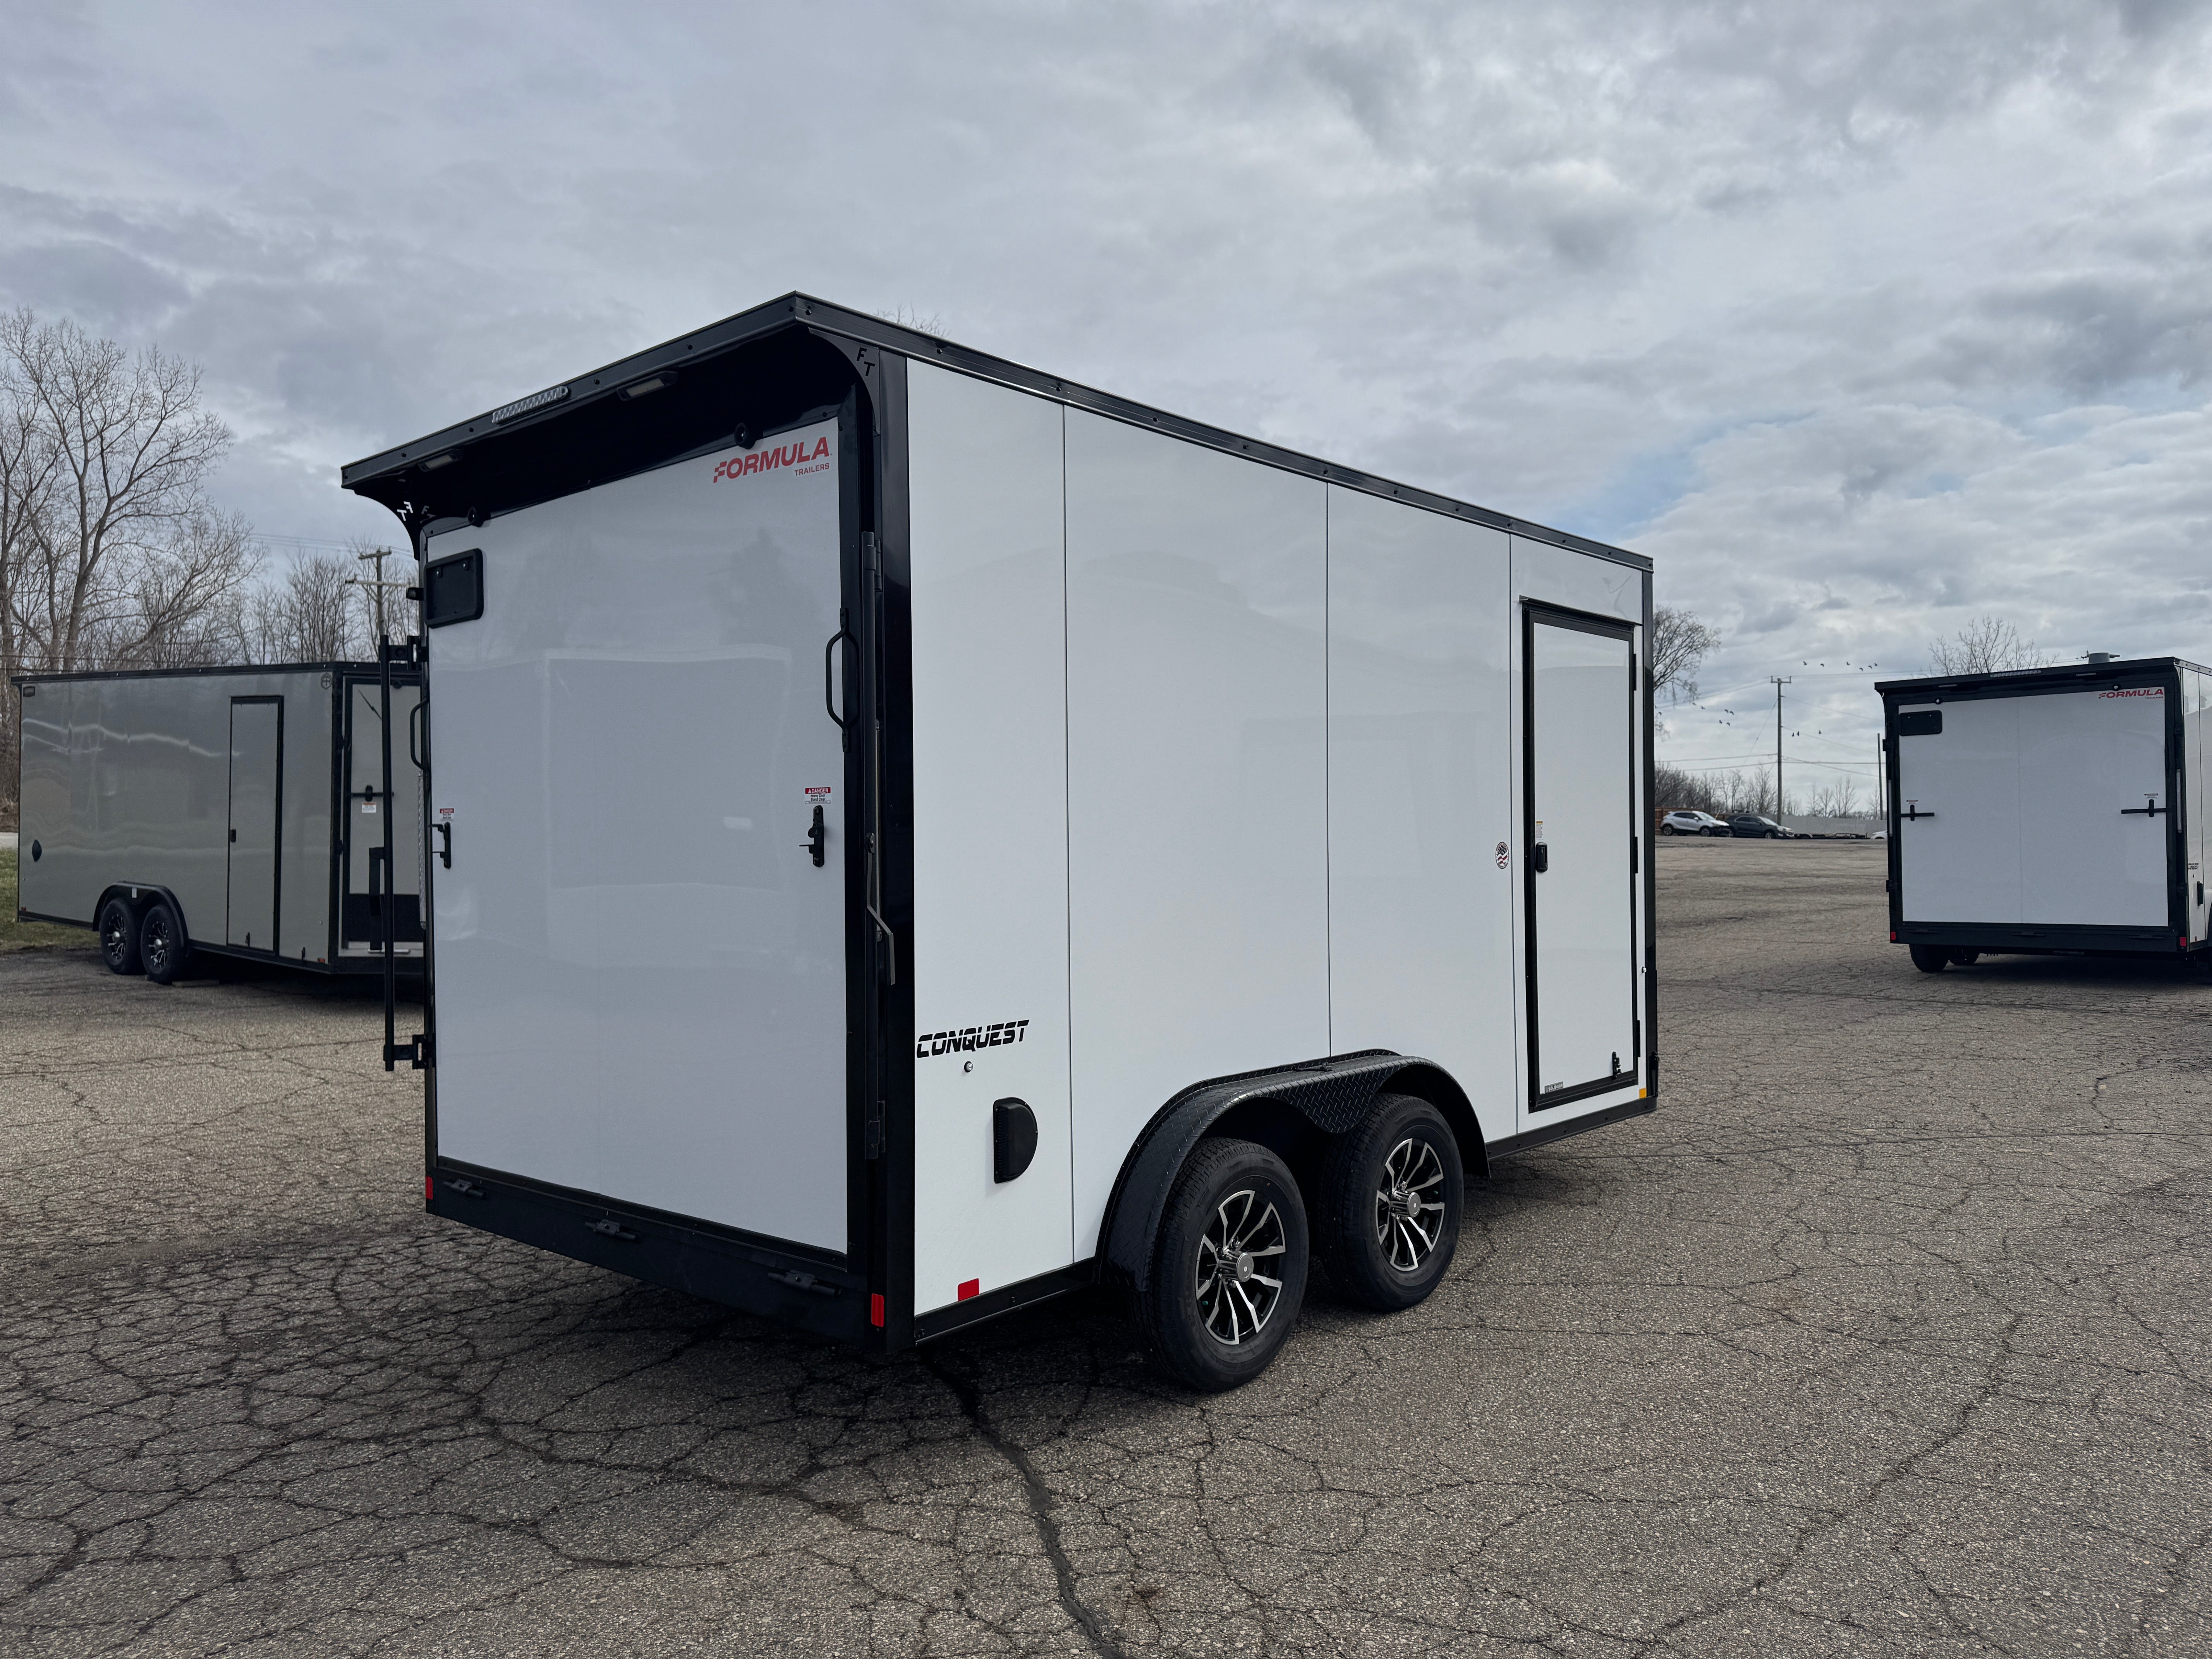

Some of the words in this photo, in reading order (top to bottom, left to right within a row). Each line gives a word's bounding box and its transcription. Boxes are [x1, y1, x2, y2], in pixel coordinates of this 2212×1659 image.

[713, 436, 830, 483] FORMULA
[795, 463, 830, 476] TRAILERS
[2099, 689, 2163, 699] FORMULA
[916, 1019, 1030, 1058] CONQUEST
